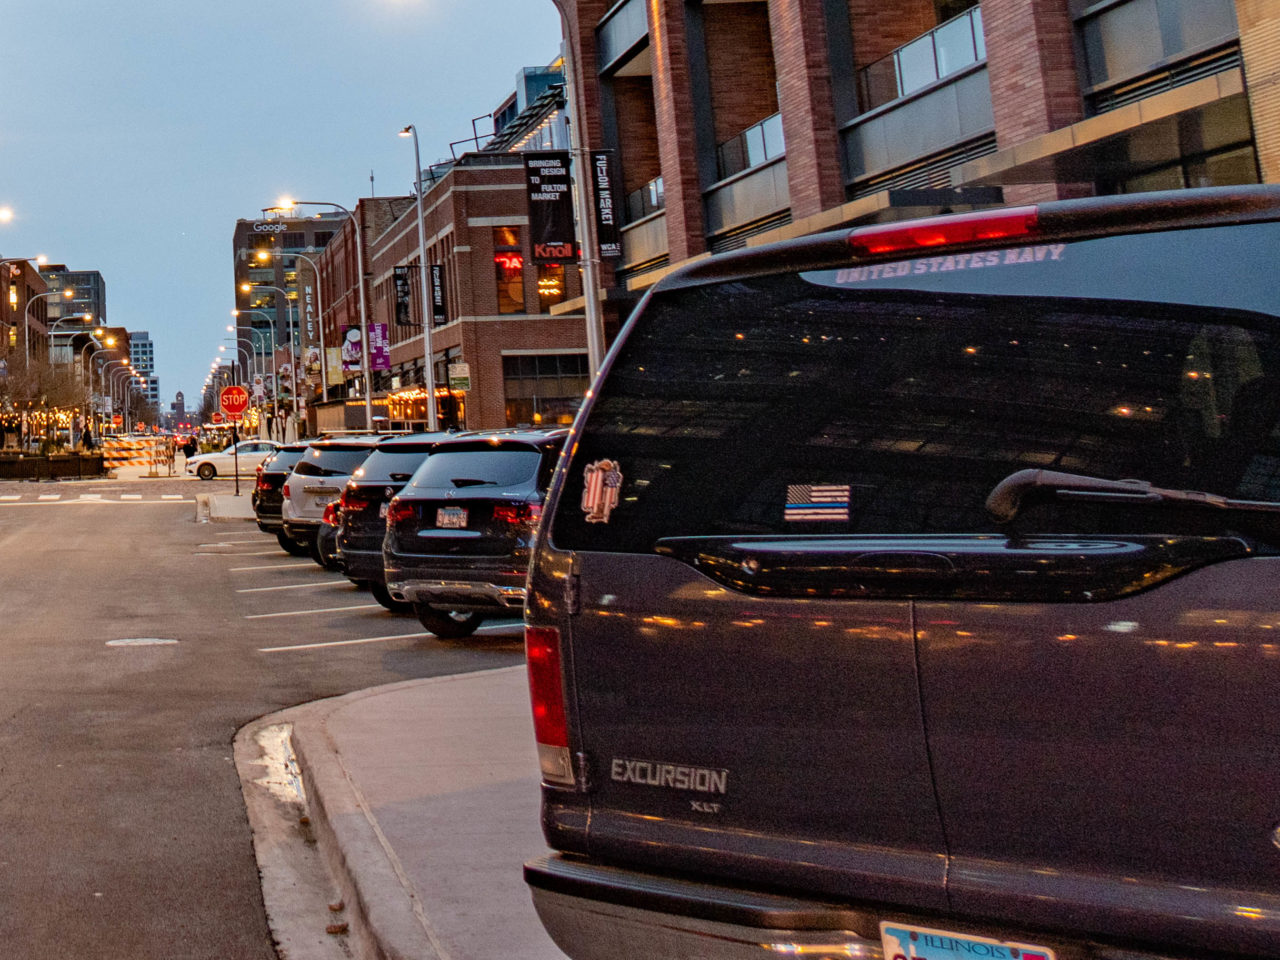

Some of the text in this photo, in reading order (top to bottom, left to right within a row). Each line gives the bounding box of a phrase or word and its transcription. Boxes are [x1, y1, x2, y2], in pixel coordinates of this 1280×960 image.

[528, 159, 562, 168] BRINGING
[540, 167, 566, 176] DESIGN
[530, 176, 540, 184] TO
[541, 183, 568, 192] FULTON
[595, 155, 614, 226] FULTON MARKET
[531, 192, 561, 201] MARKET
[253, 223, 288, 233] Google
[534, 243, 573, 258] Knoll
[835, 243, 1066, 285] UNITED STATES NAVY
[305, 285, 314, 340] NEALEY
[222, 394, 246, 406] STOP
[610, 758, 728, 794] EXCURSION
[689, 800, 722, 814] XLT
[923, 934, 1007, 959] ILLINOIS
